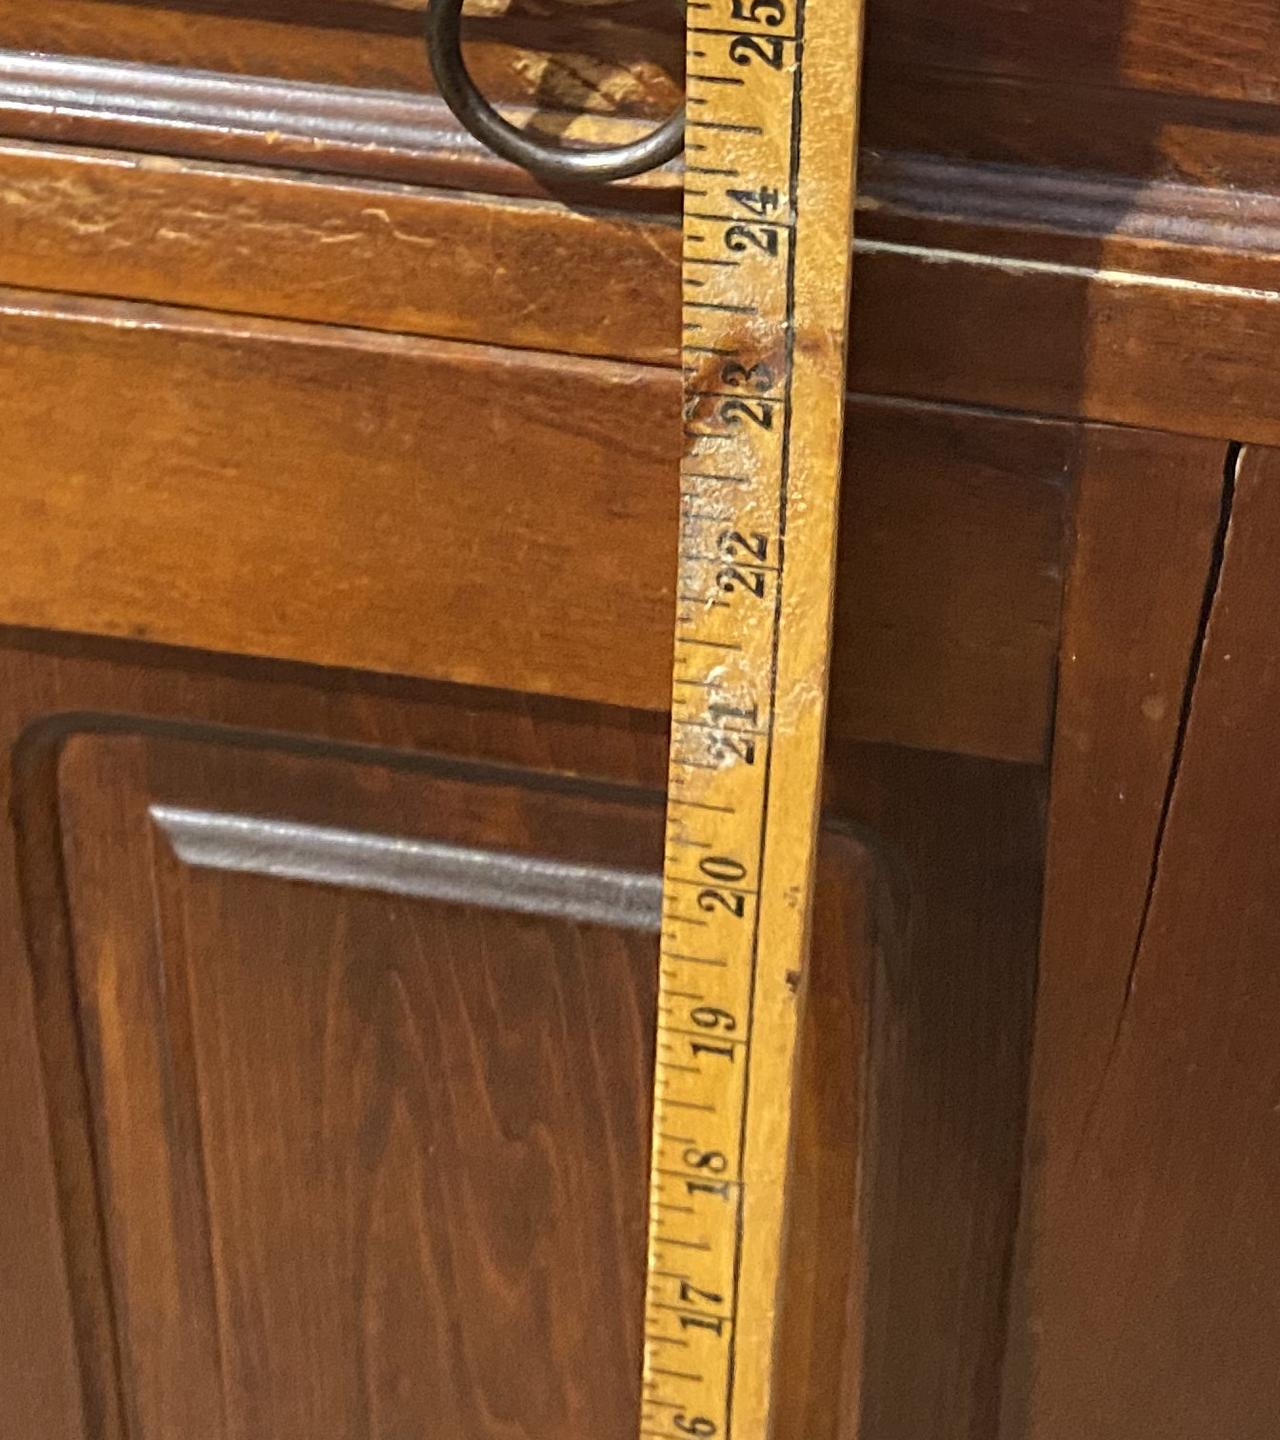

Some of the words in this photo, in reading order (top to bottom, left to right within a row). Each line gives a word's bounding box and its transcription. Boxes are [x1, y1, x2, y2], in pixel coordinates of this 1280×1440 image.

[723, 184, 780, 258] 24
[719, 361, 774, 432] 23
[716, 529, 769, 600] 22
[707, 701, 760, 767] 21
[697, 854, 748, 920] 20
[690, 1005, 737, 1063] 19
[682, 1146, 730, 1203] 18
[679, 1279, 724, 1339] 17
[673, 1412, 717, 1440] 6
